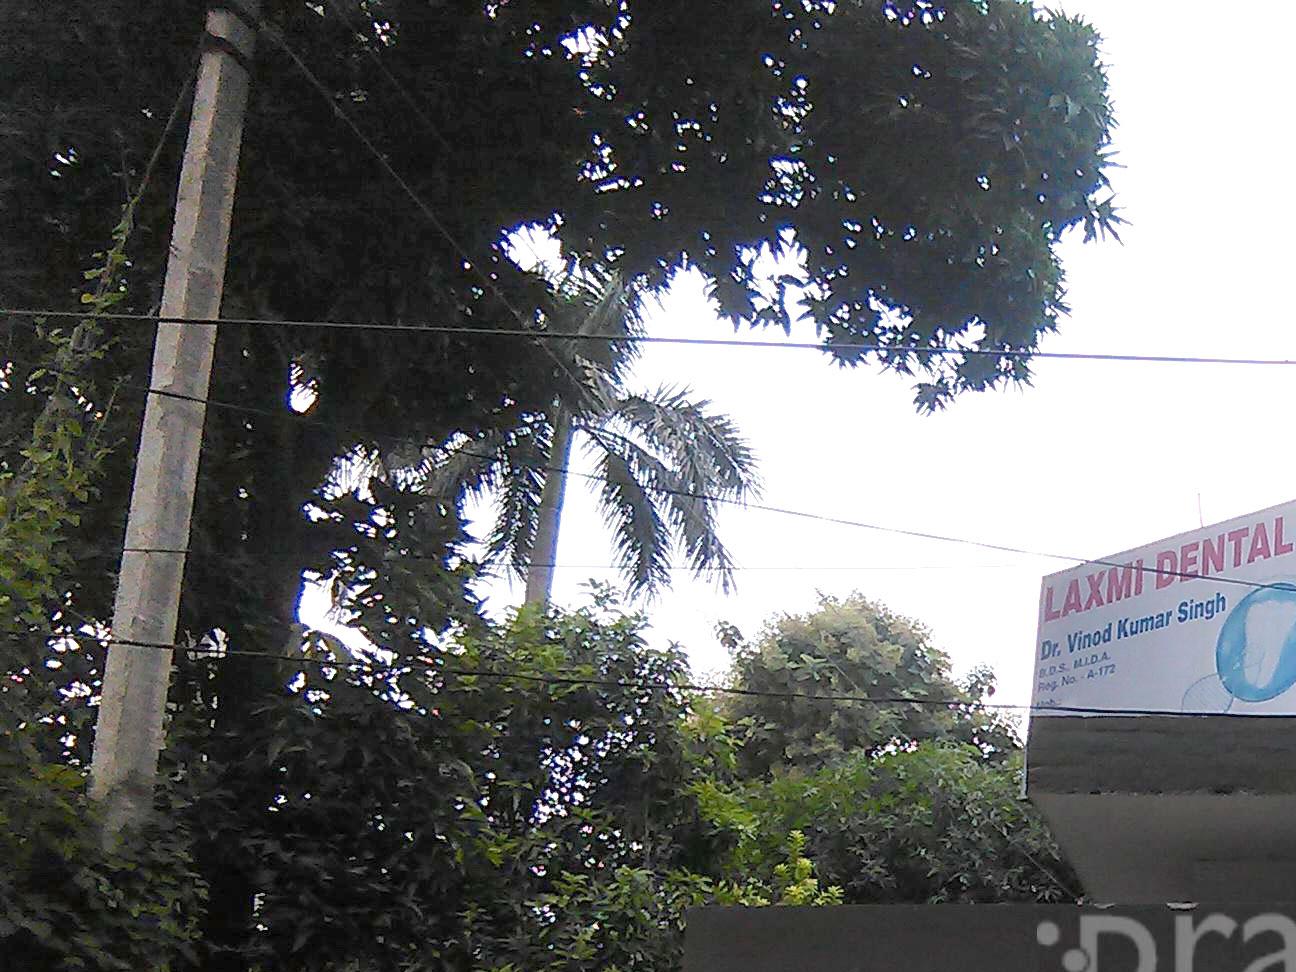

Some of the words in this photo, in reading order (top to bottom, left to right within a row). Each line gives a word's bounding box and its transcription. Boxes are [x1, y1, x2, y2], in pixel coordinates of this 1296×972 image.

[1044, 558, 1143, 622] LAXMI
[1156, 516, 1294, 591] DENTAL
[1040, 638, 1062, 660] Dr.
[1067, 622, 1112, 654] Vinod
[1117, 610, 1173, 640] Kumar
[1177, 593, 1227, 623] Singh
